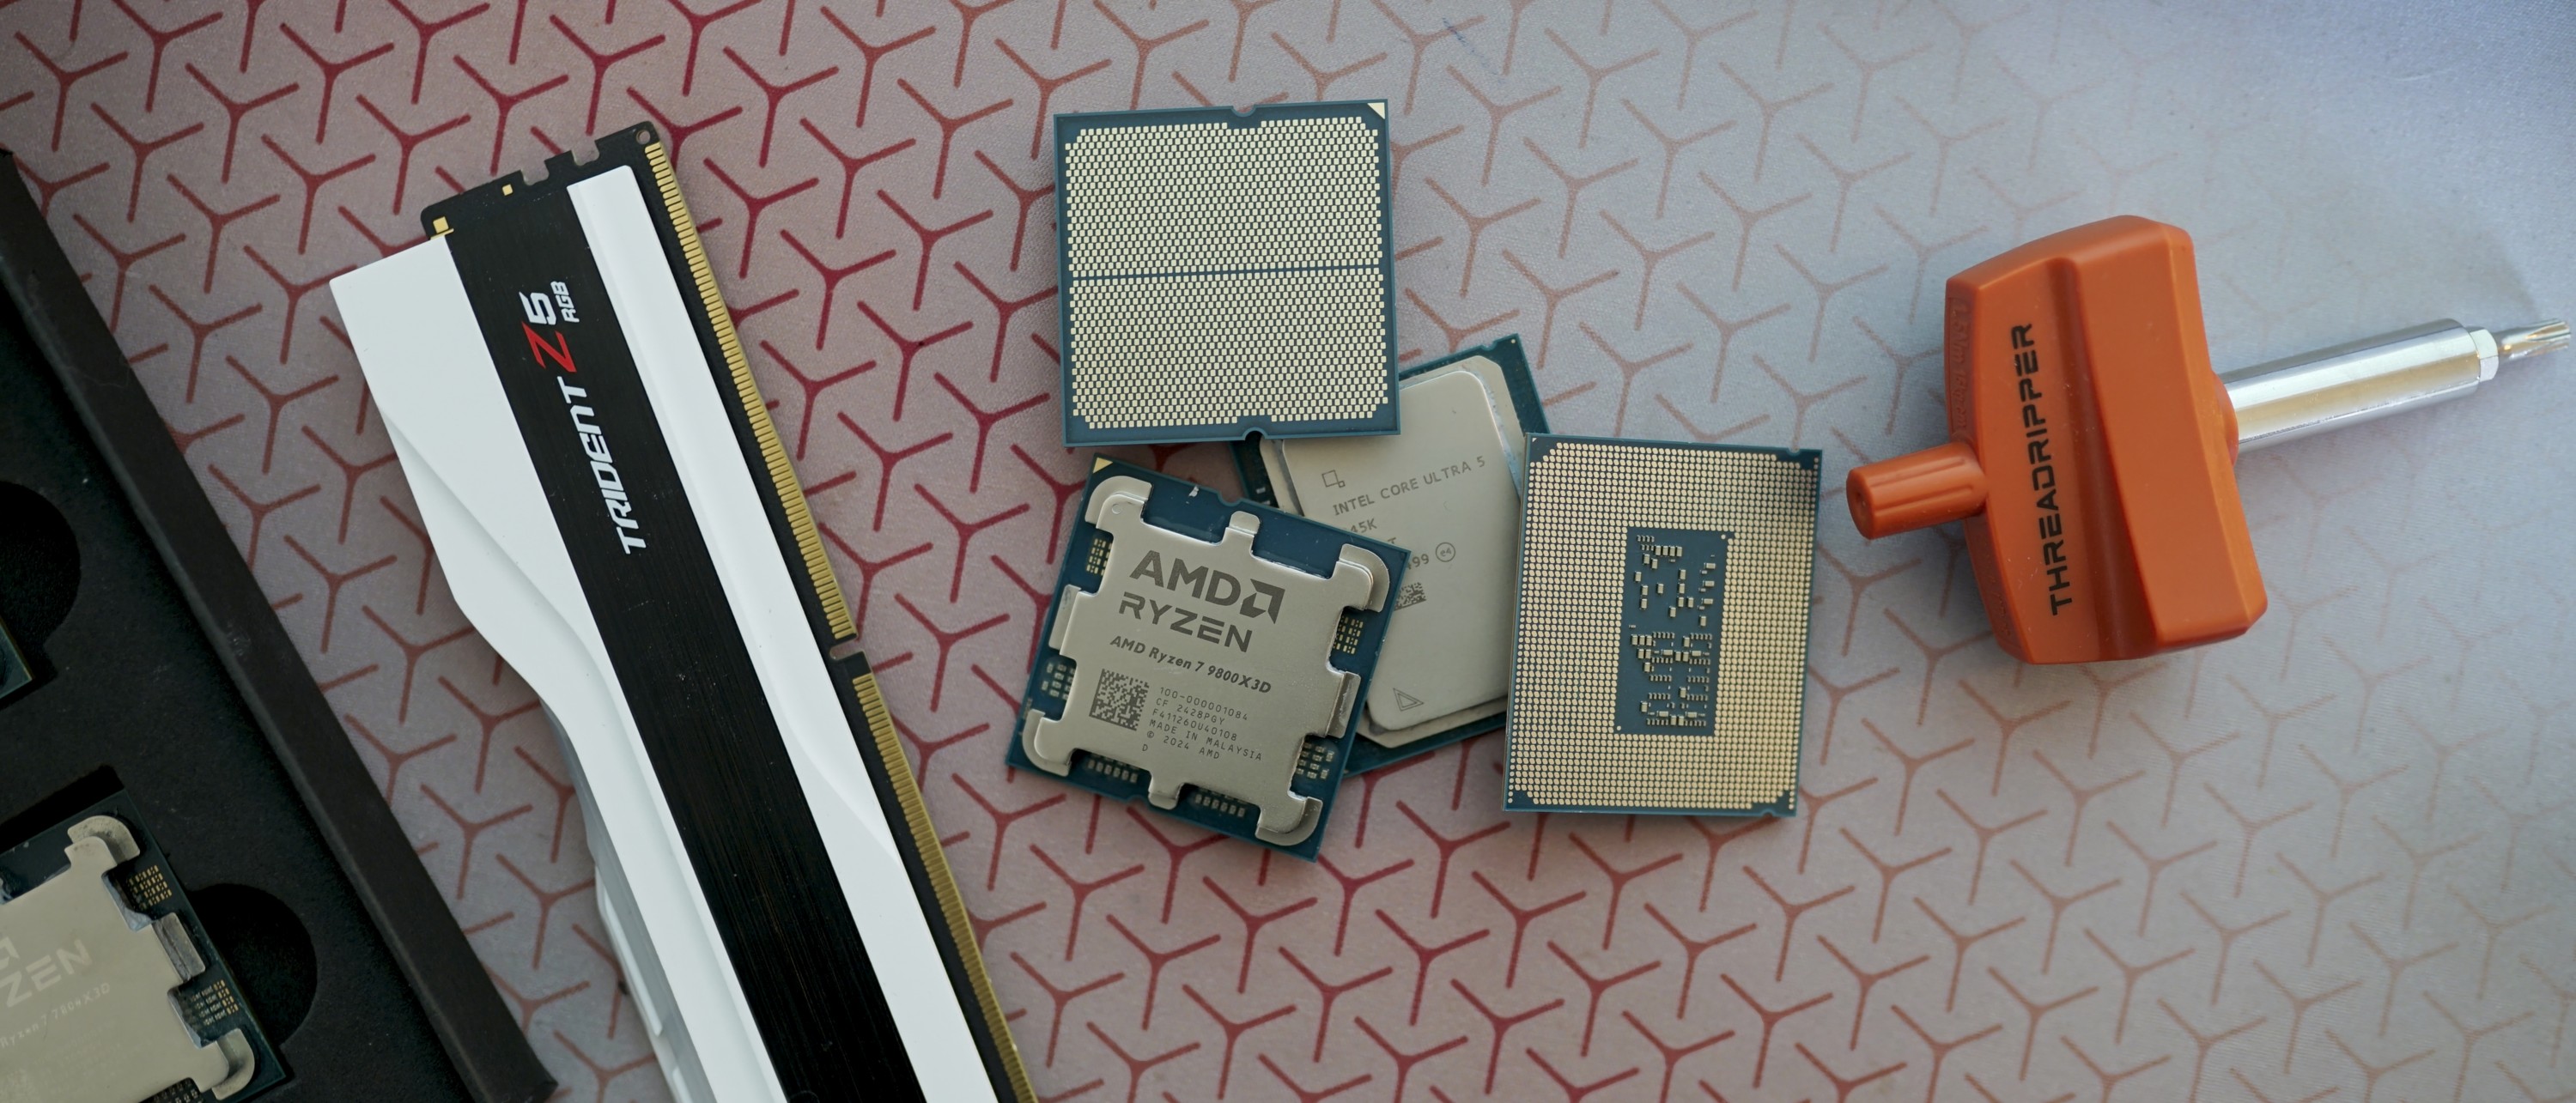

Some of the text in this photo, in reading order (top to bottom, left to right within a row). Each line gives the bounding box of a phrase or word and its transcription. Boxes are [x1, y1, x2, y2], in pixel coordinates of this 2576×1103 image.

[550, 281, 580, 323] RGB
[557, 376, 646, 555] TRIDENT
[1333, 456, 1485, 515] INTEL CORE ULTRA 5
[2011, 323, 2073, 615] THREADRIPPER
[1350, 518, 1377, 533] 45K
[1129, 549, 1242, 606] AMD
[1408, 554, 1430, 570] 99
[1118, 591, 1253, 652] RYZEN
[1110, 635, 1272, 694] AMD Ryzen 7 9800X3D
[1156, 698, 1225, 725] CF 2428PGY
[1159, 687, 1248, 720] 100-000001084
[1142, 743, 1148, 752] D
[1149, 719, 1262, 761] MADE IN MALAYSIA
[1163, 736, 1189, 749] 2024
[1199, 747, 1220, 759] AMD
